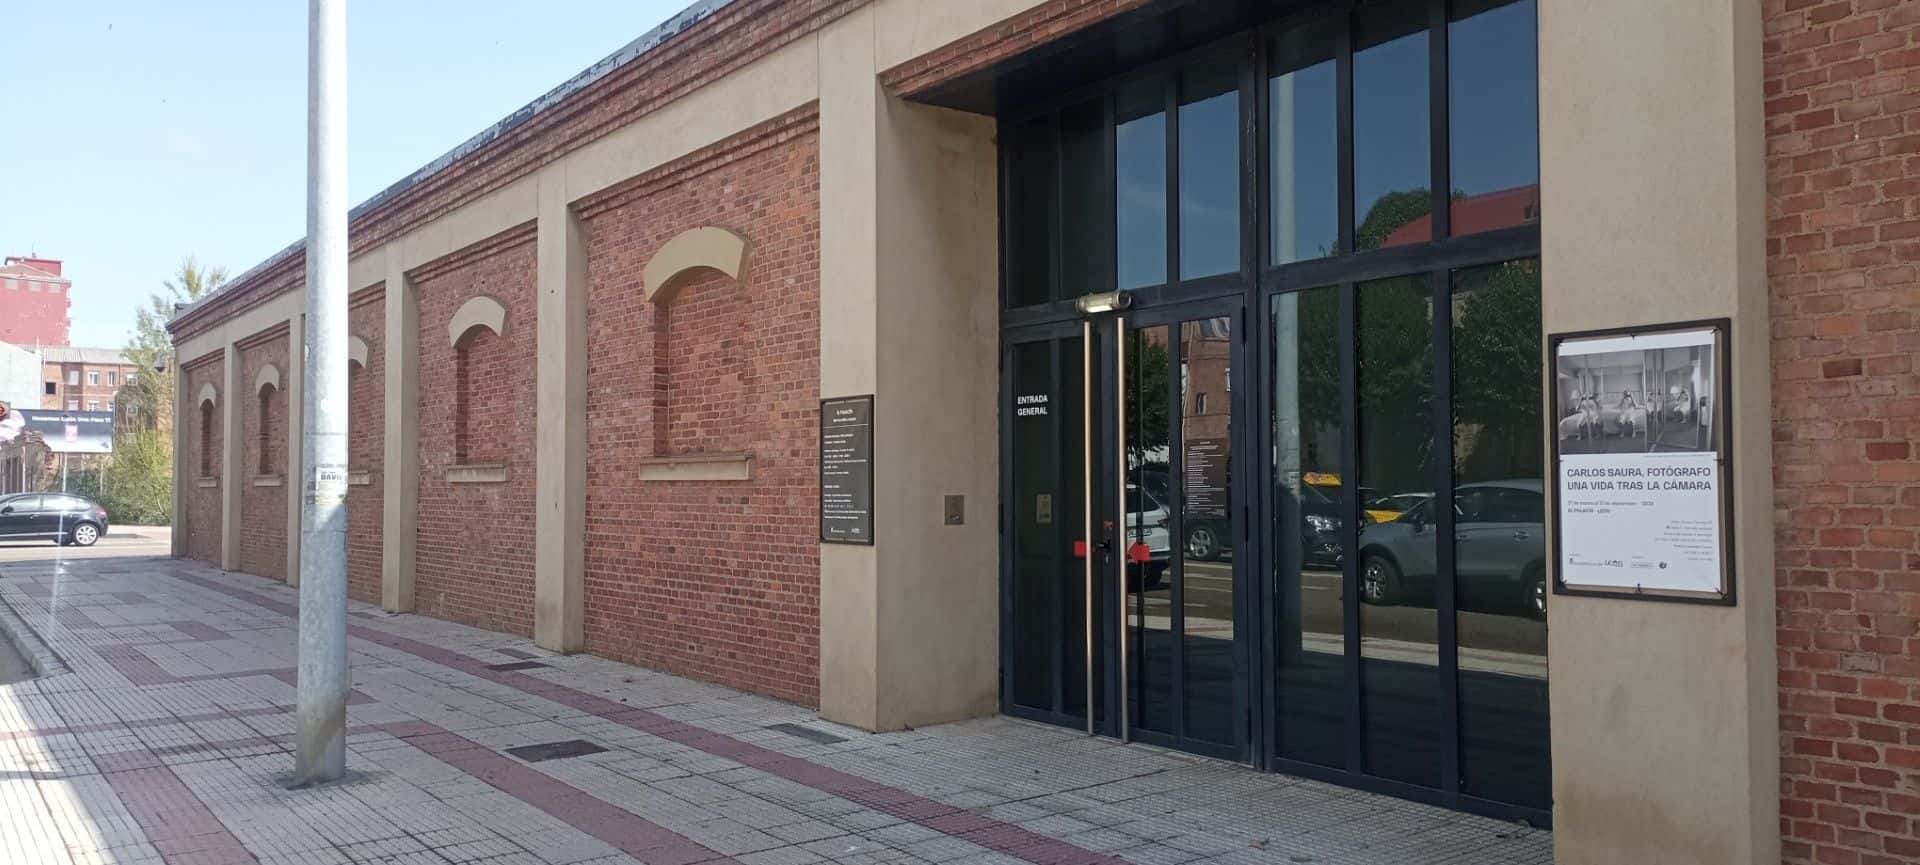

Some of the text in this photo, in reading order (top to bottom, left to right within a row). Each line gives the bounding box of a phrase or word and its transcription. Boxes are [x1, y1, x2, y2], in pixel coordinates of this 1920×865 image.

[1017, 395, 1048, 404] ENTRADA
[1017, 407, 1048, 416] GENERAL
[1567, 466, 1711, 478] CARLOS SAURA, FOTÓGRAFO
[1567, 479, 1711, 490] UNA VIDA TRAS LA CÁMARA
